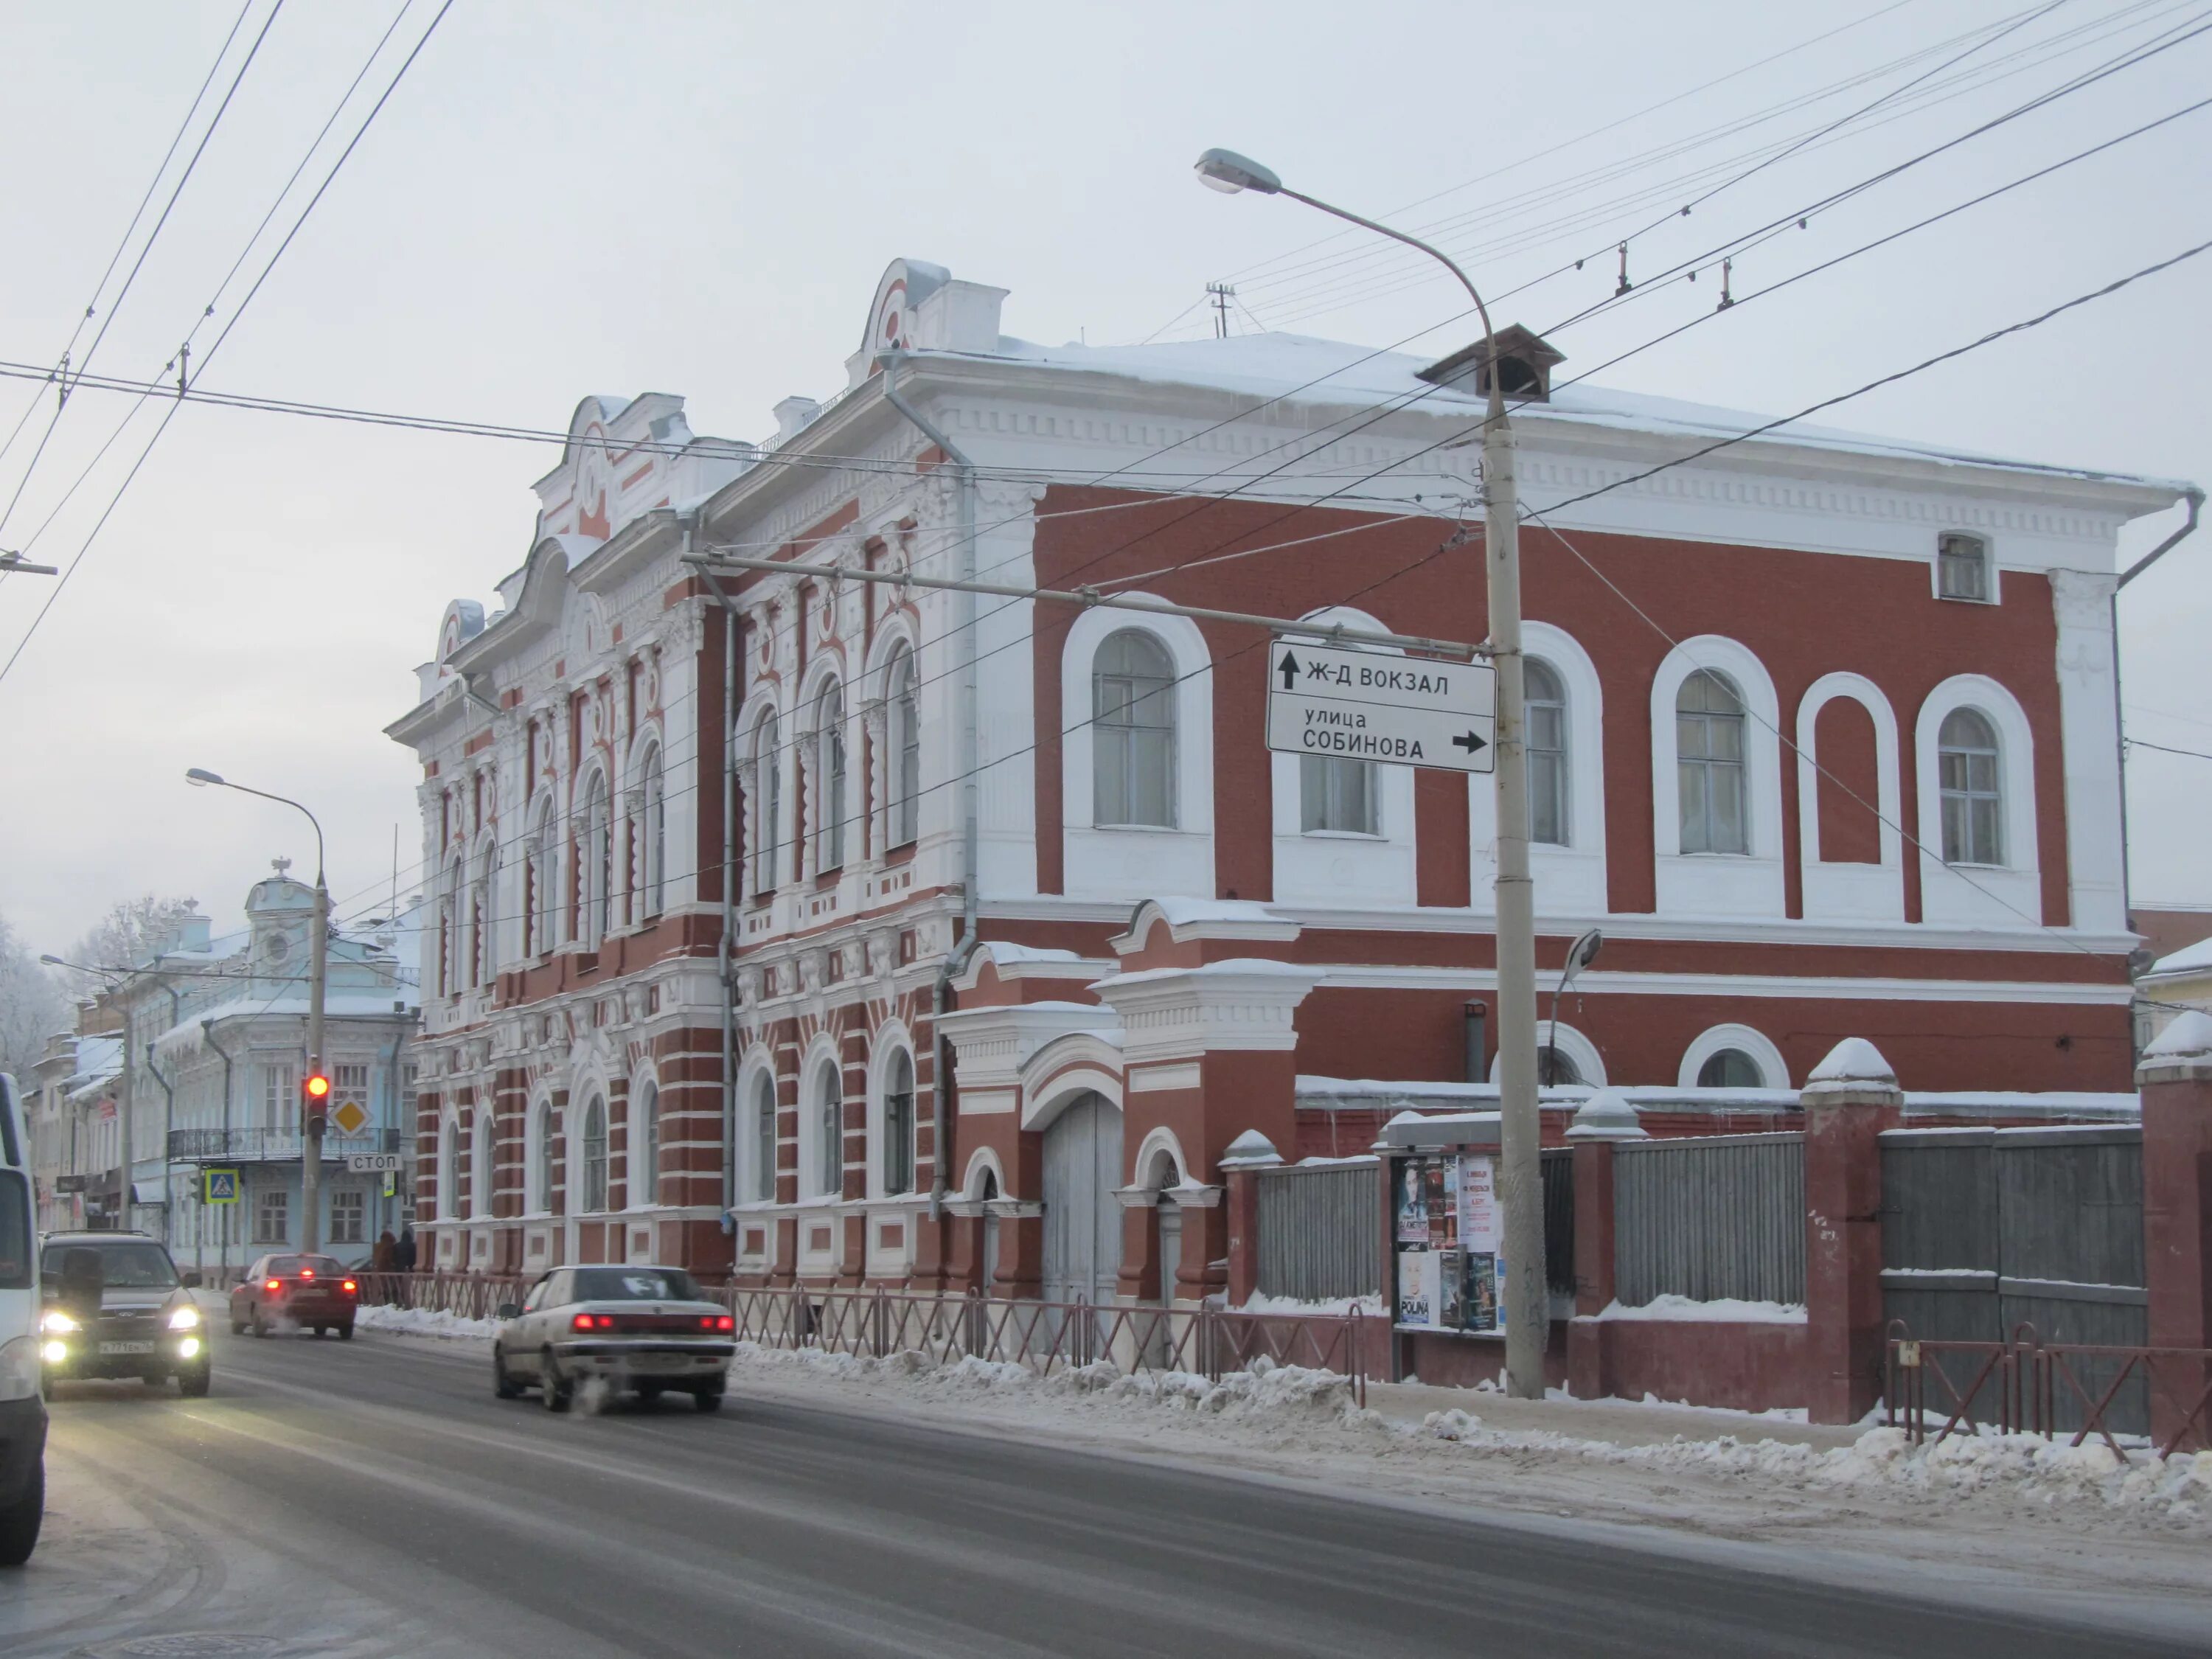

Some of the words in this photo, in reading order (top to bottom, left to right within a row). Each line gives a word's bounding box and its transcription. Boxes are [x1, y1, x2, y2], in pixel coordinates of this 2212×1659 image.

[1307, 661, 1352, 686] Ж-Д
[1360, 667, 1448, 695] ВОКЗАЛ
[1304, 709, 1366, 728] улица
[1303, 729, 1424, 759] СОБИНОВА
[355, 1156, 395, 1169] СТОП
